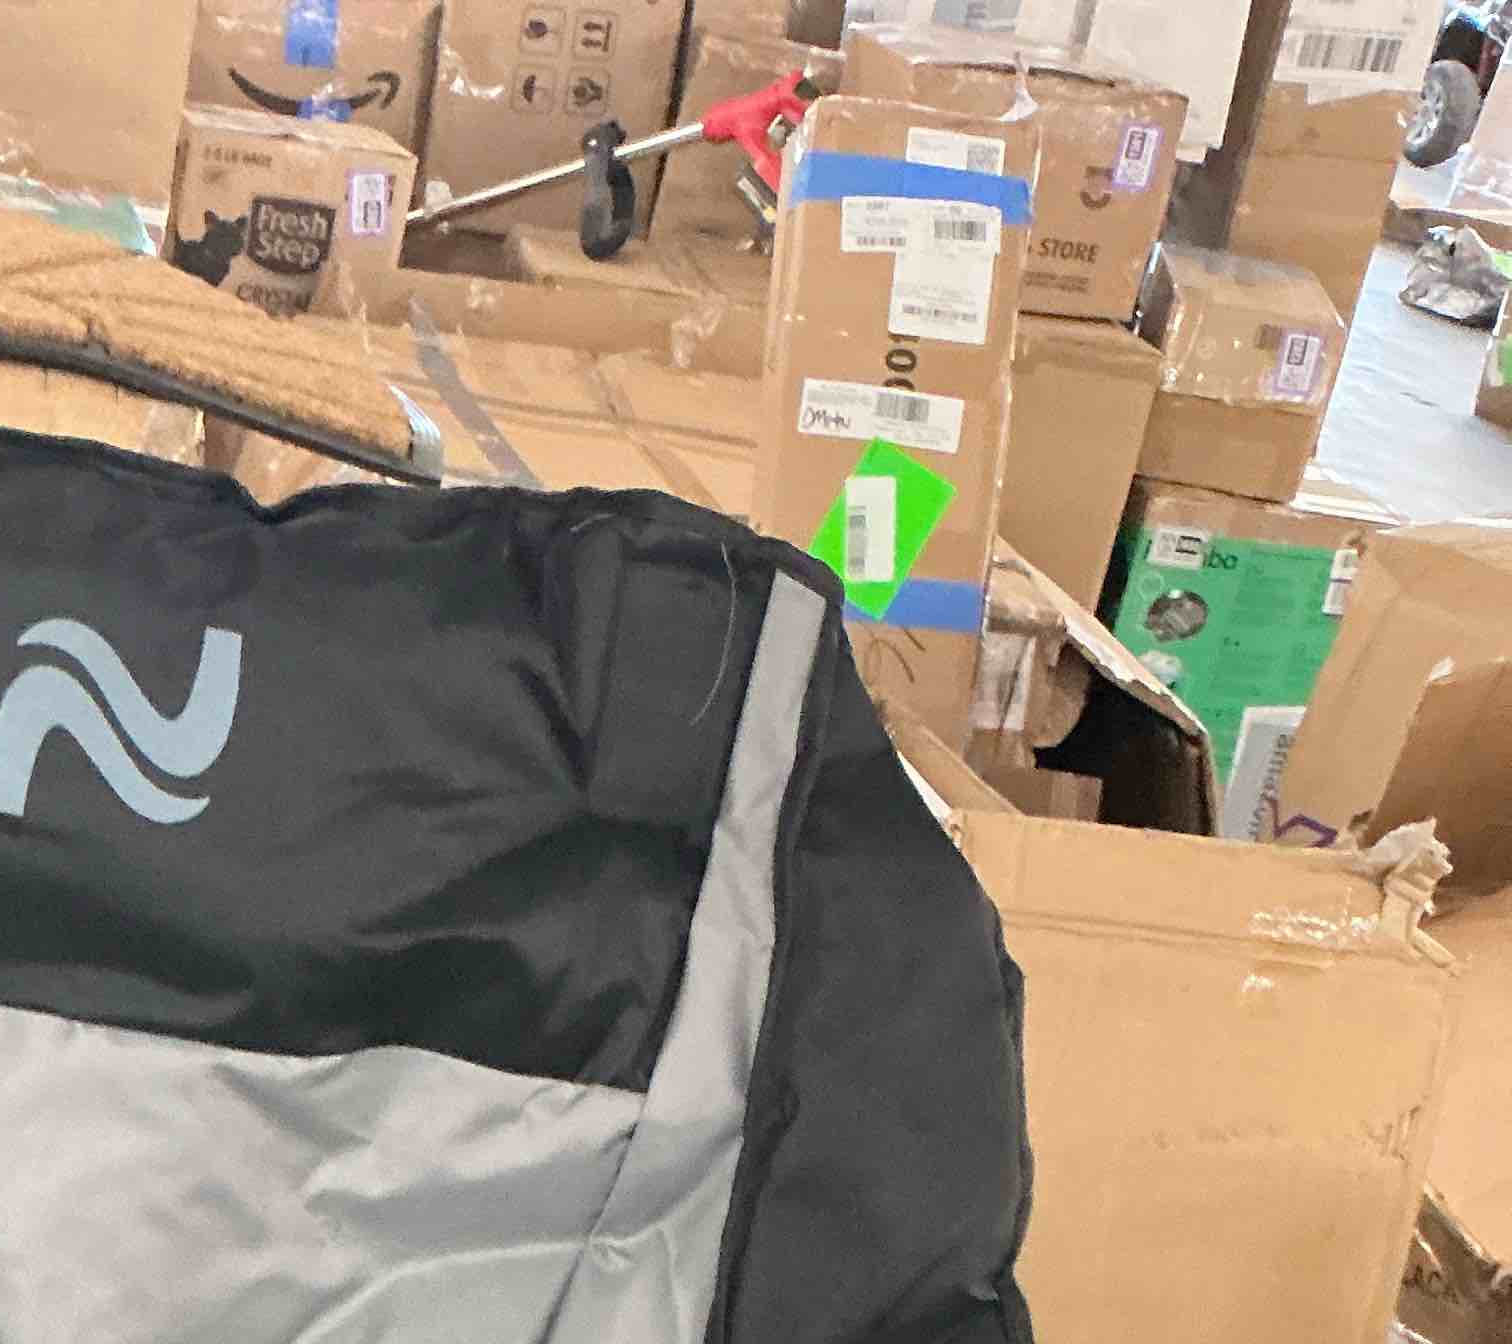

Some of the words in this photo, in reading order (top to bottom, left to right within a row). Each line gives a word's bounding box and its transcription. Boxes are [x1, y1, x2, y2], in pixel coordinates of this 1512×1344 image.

[258, 203, 329, 240] Fresh
[254, 232, 321, 268] Step
[1039, 237, 1100, 264] STORE
